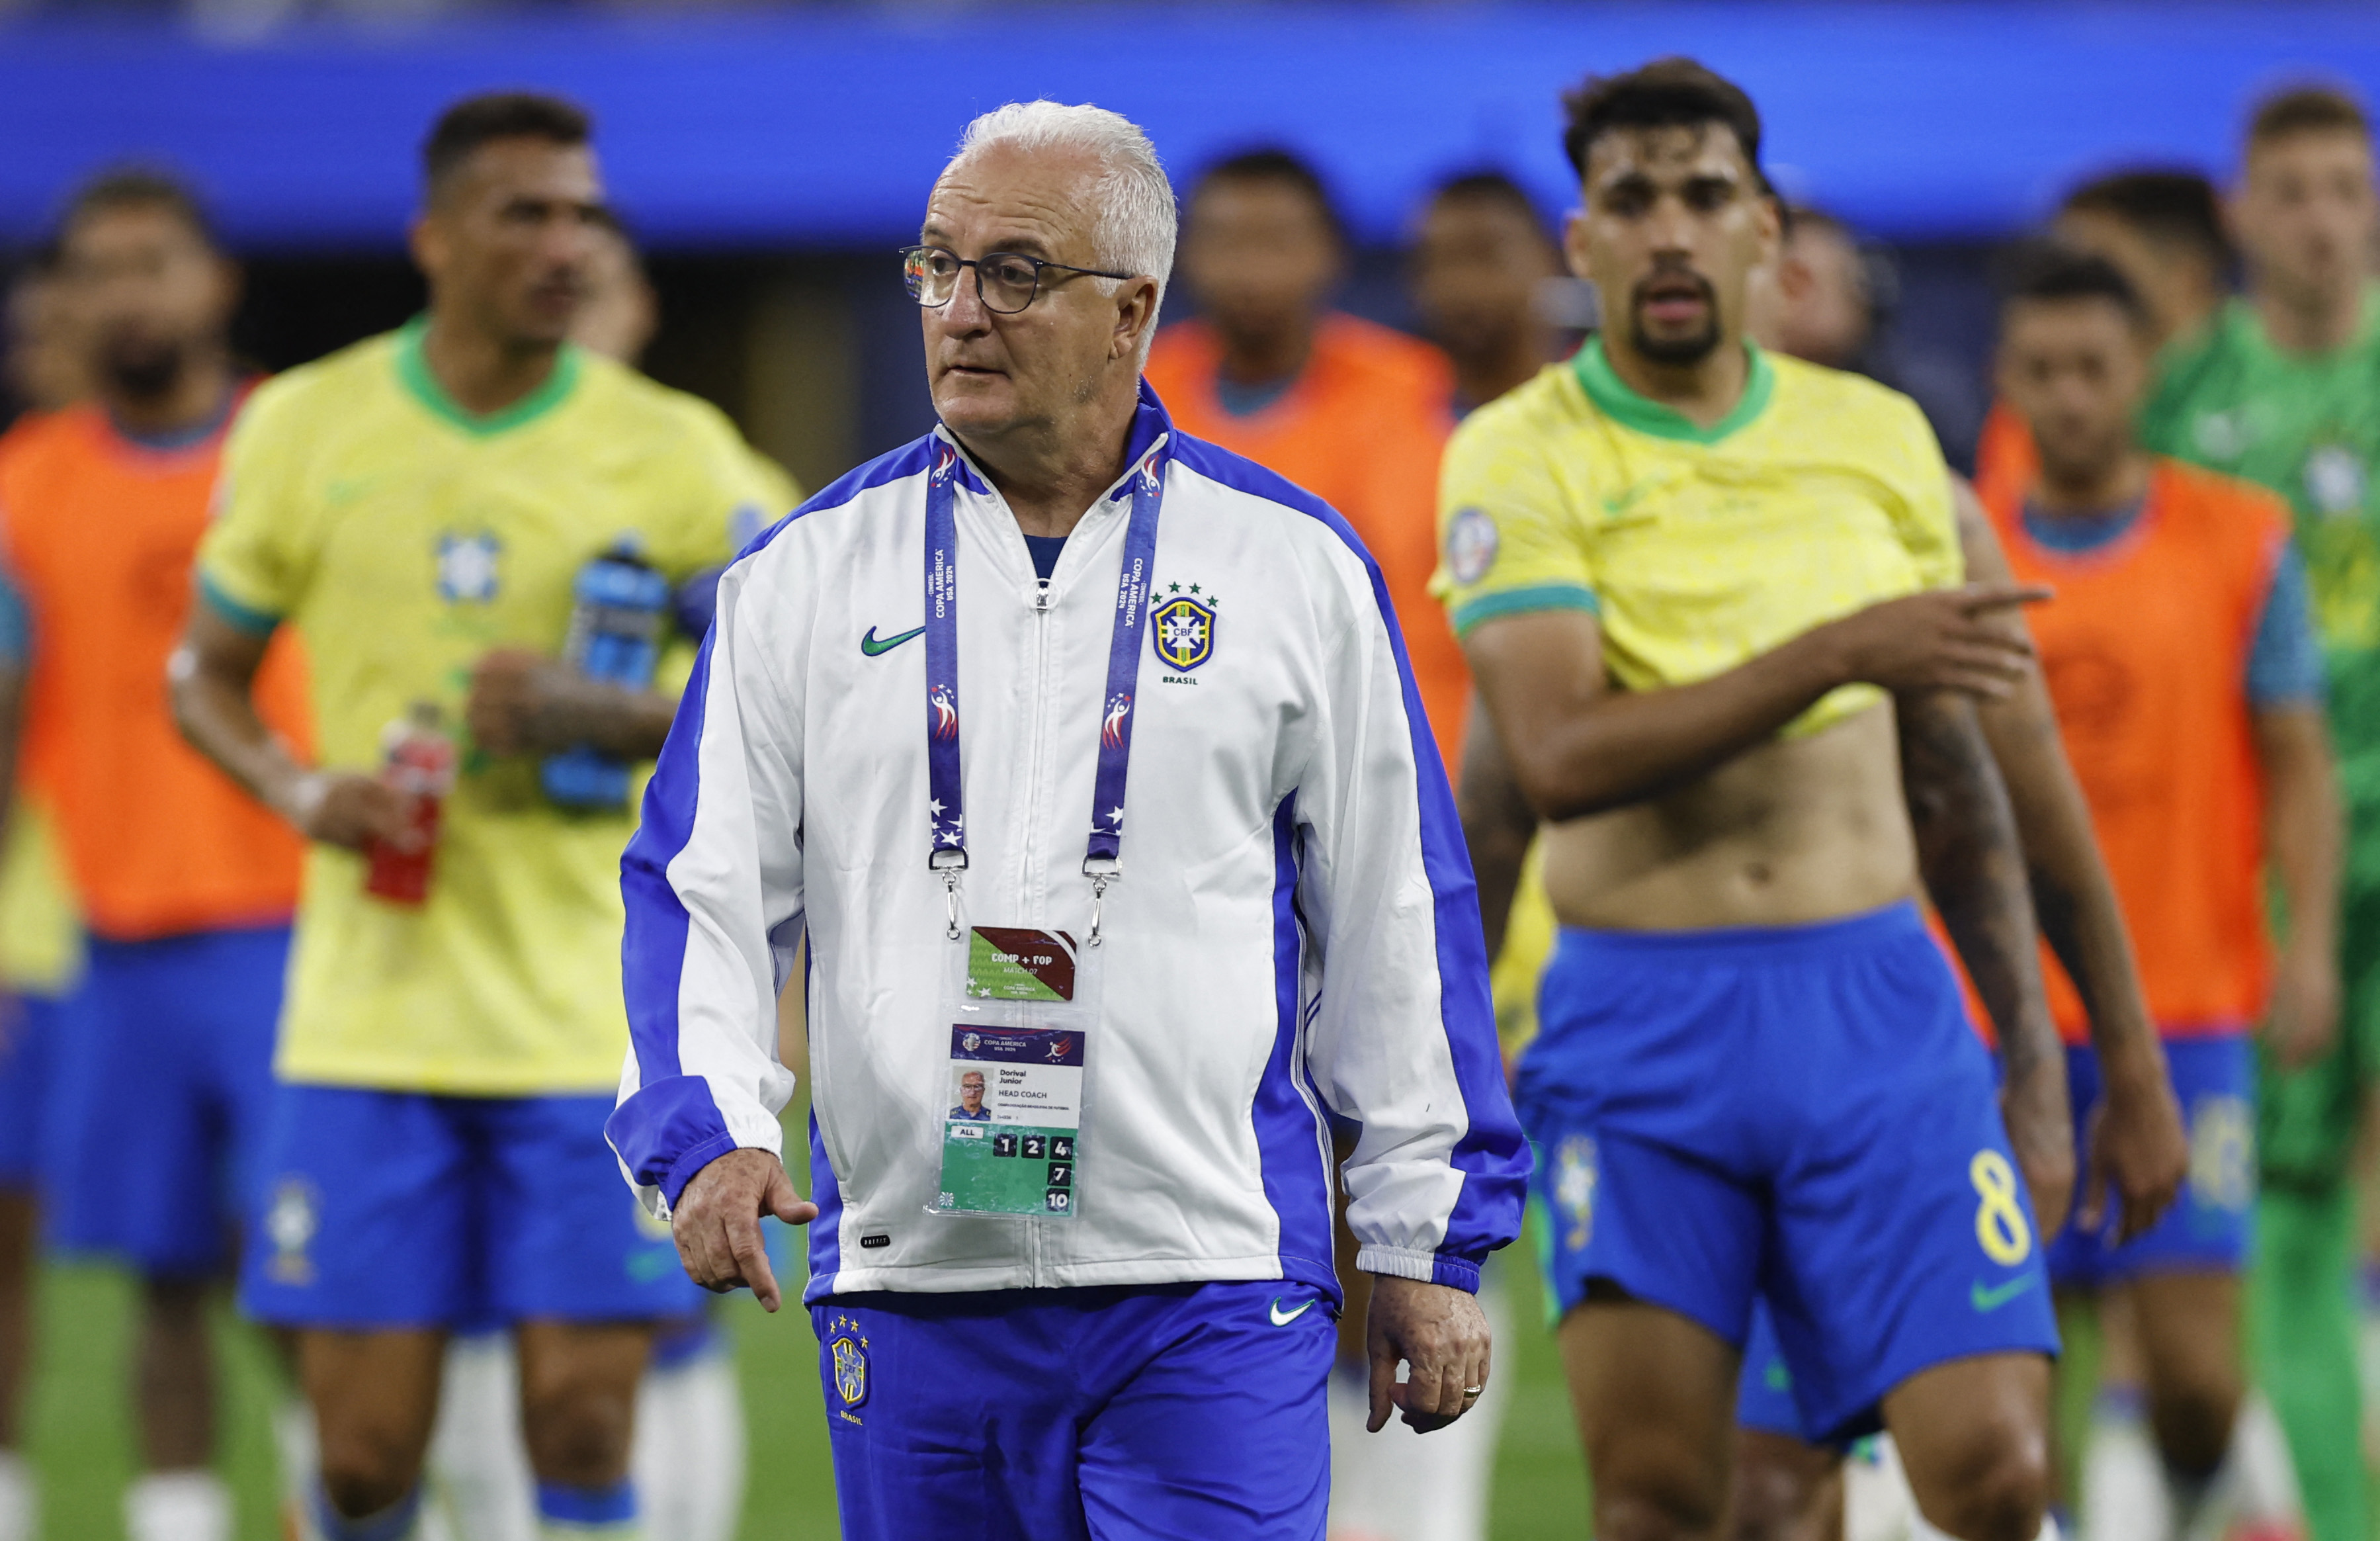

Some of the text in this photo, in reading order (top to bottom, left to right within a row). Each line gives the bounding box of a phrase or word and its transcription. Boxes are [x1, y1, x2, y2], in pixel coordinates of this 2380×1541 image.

[935, 549, 945, 618] COPA AMERICA
[1119, 573, 1130, 609] USA 2024
[1125, 558, 1143, 627] COPA AMERICA
[1163, 676, 1198, 685] BRASIL
[992, 953, 1019, 963] COMP
[1033, 955, 1052, 965] FOP
[1001, 1139, 1066, 1156] 1 2 4
[1054, 1167, 1065, 1181] 7
[1048, 1195, 1068, 1207] 10
[1969, 1147, 2031, 1267] 8
[844, 1364, 856, 1373] CBF
[840, 1410, 863, 1426] BRASIL
